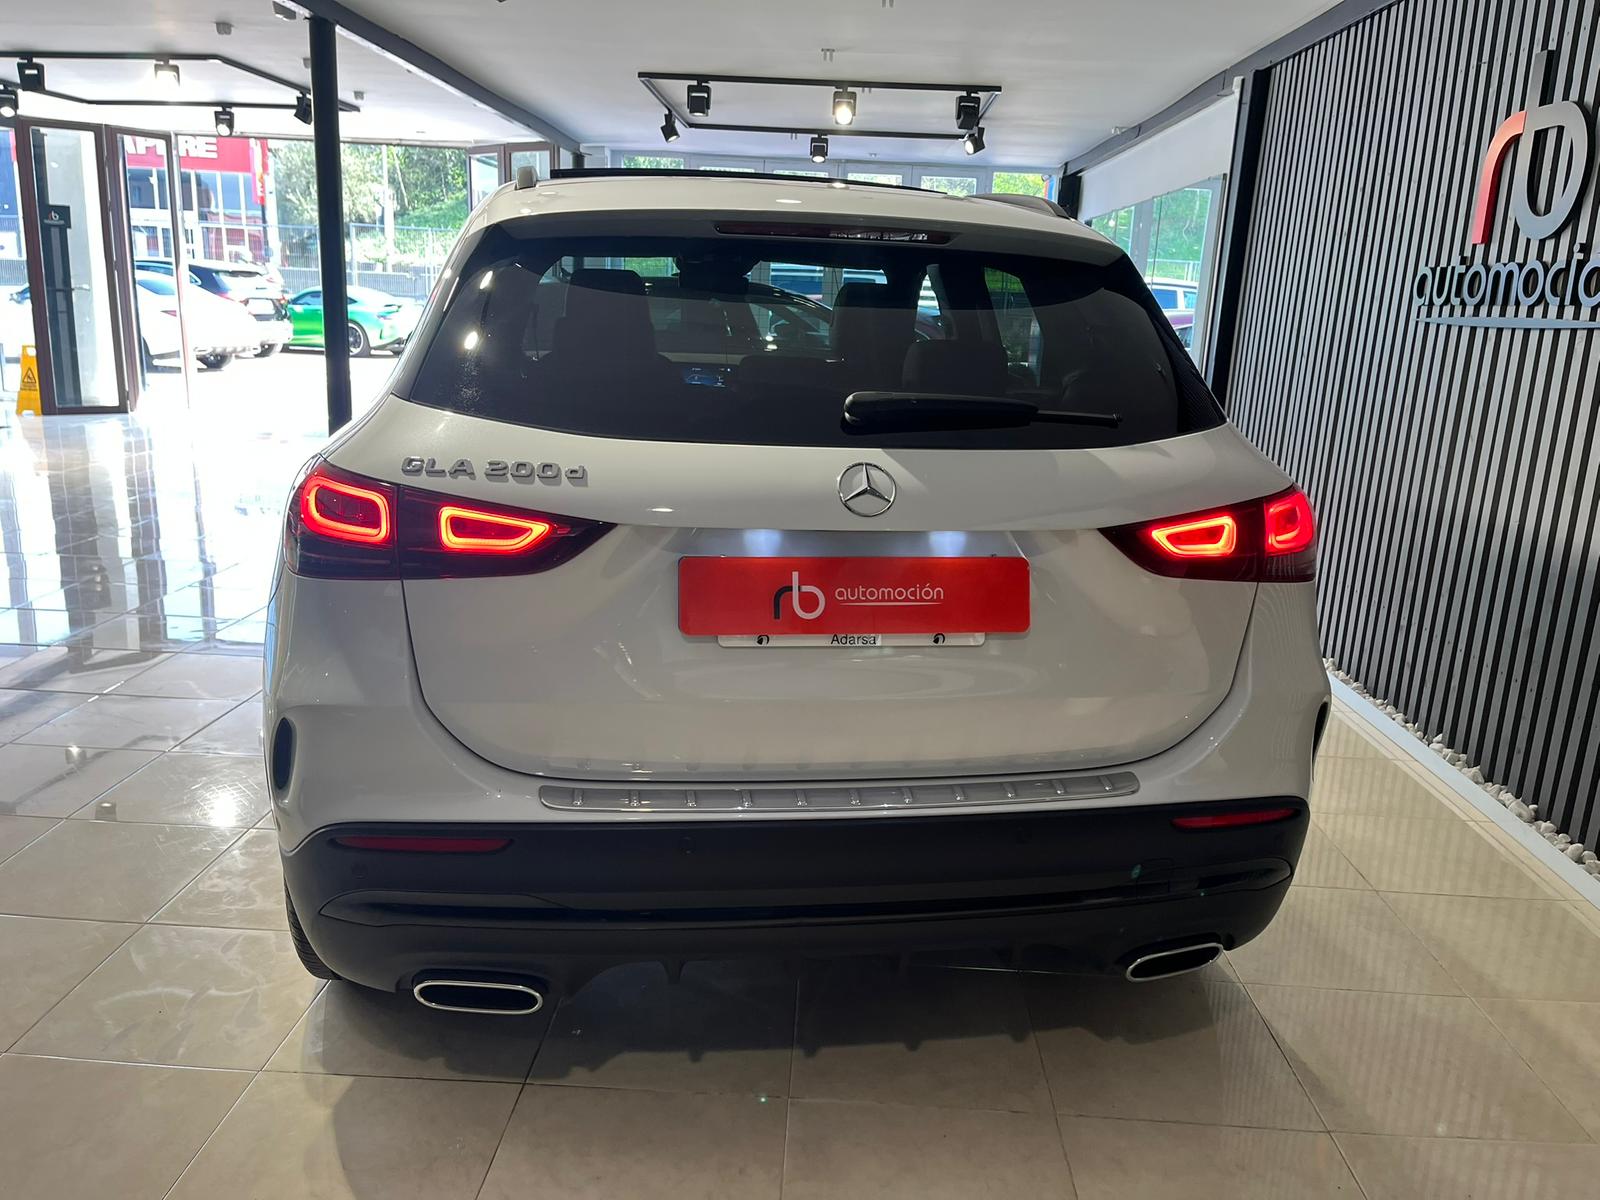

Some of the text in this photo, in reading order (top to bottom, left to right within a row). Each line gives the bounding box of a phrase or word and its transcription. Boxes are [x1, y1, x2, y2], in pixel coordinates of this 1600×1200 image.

[401, 456, 476, 480] GLA
[834, 583, 944, 600] automoción
[830, 633, 877, 645] Adarsa
